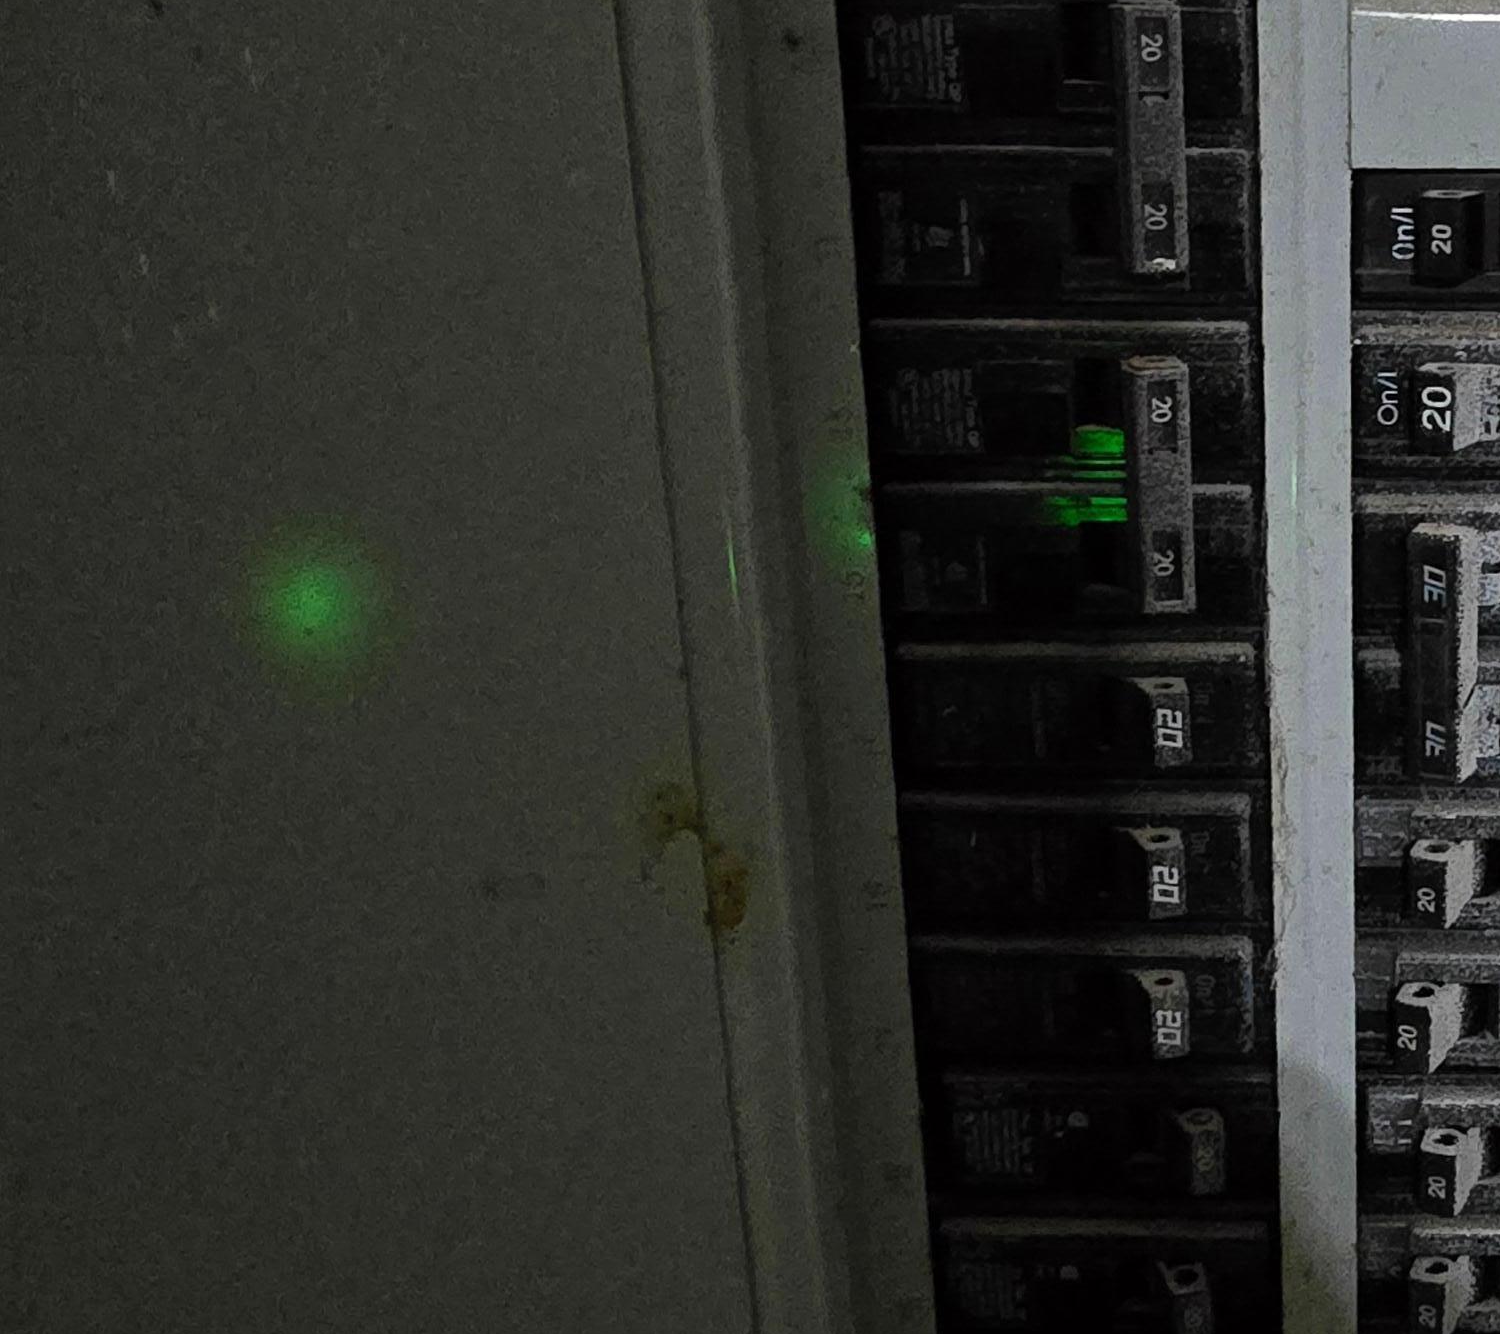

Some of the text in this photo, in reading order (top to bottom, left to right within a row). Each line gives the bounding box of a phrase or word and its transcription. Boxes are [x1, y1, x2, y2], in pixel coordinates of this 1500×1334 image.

[1140, 33, 1164, 63] 20
[1144, 202, 1168, 231] 20
[1430, 224, 1453, 256] 20
[1150, 395, 1173, 424] 20
[1421, 386, 1452, 432] 20
[1152, 548, 1175, 577] 20
[1421, 563, 1449, 609] 30
[1153, 708, 1183, 748] 20
[1152, 864, 1180, 905] 20
[1416, 886, 1437, 914] 20
[1155, 1009, 1182, 1046] 20
[1397, 1024, 1419, 1052] 20
[1428, 1175, 1447, 1199] 20
[1418, 1304, 1438, 1328] 20
